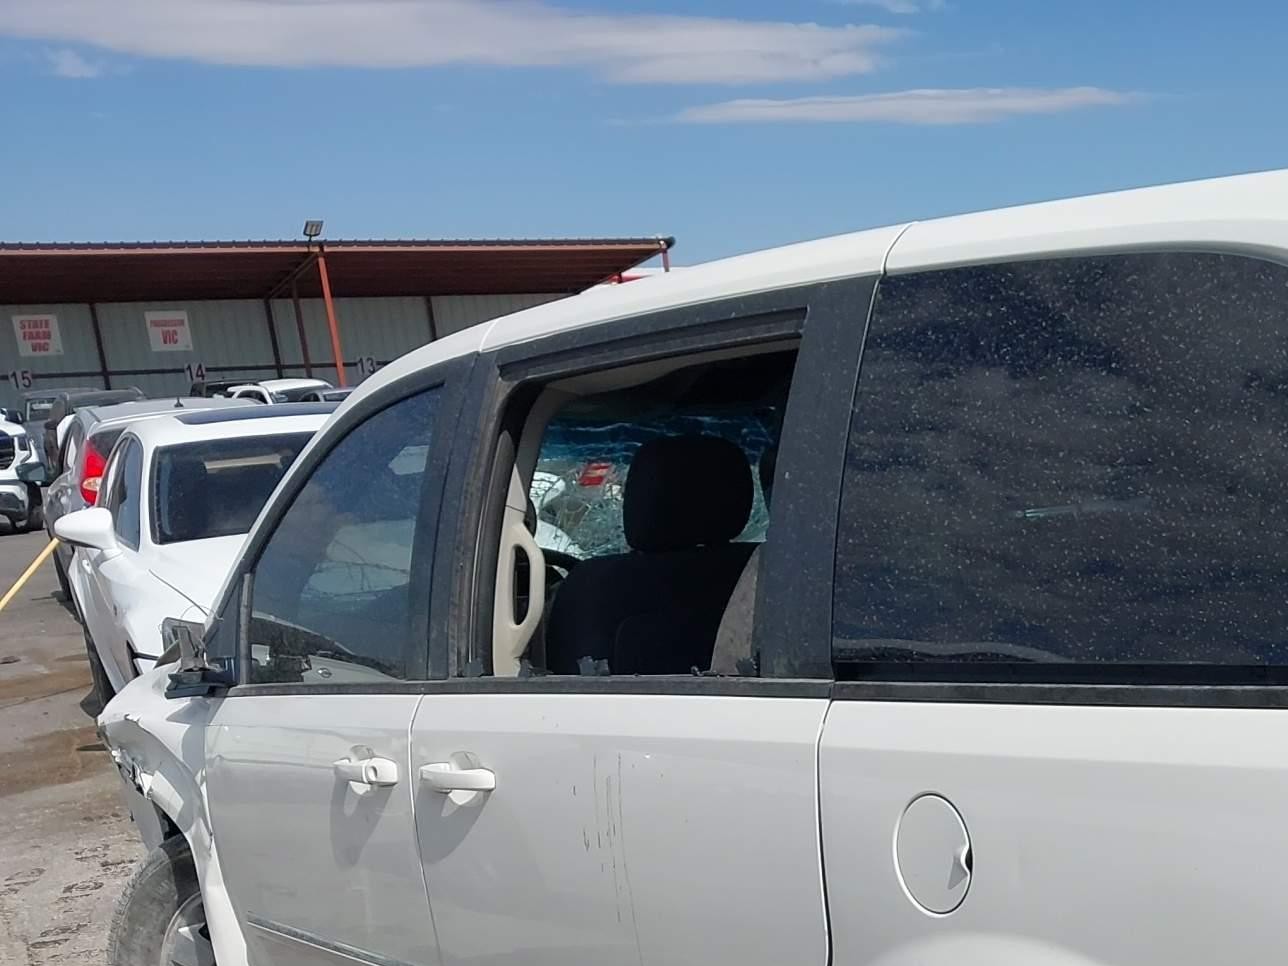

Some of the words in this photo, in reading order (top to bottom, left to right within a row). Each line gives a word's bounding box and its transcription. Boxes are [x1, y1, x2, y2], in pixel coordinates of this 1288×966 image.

[19, 319, 49, 329] STATE
[161, 329, 178, 345] VIC
[31, 342, 50, 352] VIC
[186, 363, 205, 381] 14
[357, 357, 376, 375] 13
[10, 370, 32, 389] 15
